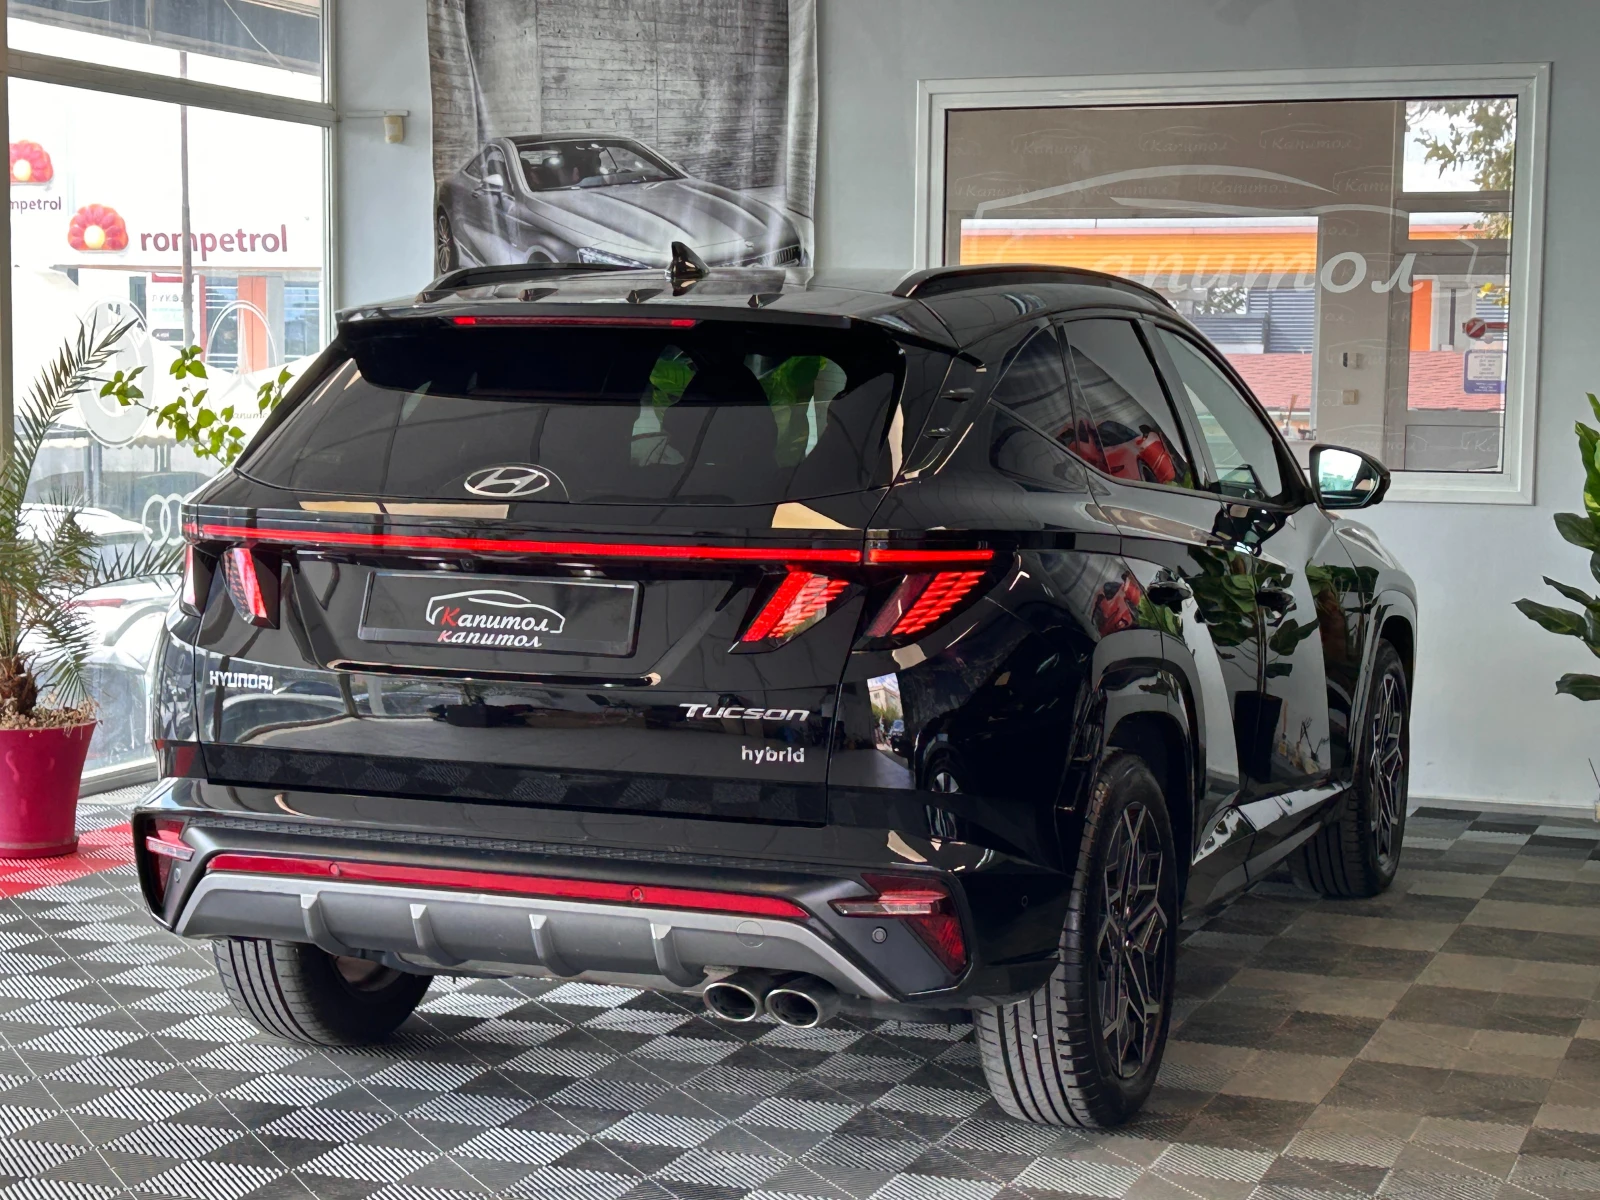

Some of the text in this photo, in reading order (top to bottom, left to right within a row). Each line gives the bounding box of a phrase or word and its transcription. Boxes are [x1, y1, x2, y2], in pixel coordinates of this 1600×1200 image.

[10, 196, 62, 214] mpetrol
[140, 224, 288, 261] rompetrol
[1090, 249, 1423, 294] апитол
[440, 606, 549, 632] Капитол
[209, 670, 274, 691] HYUNDAI
[741, 745, 805, 764] hybrid
